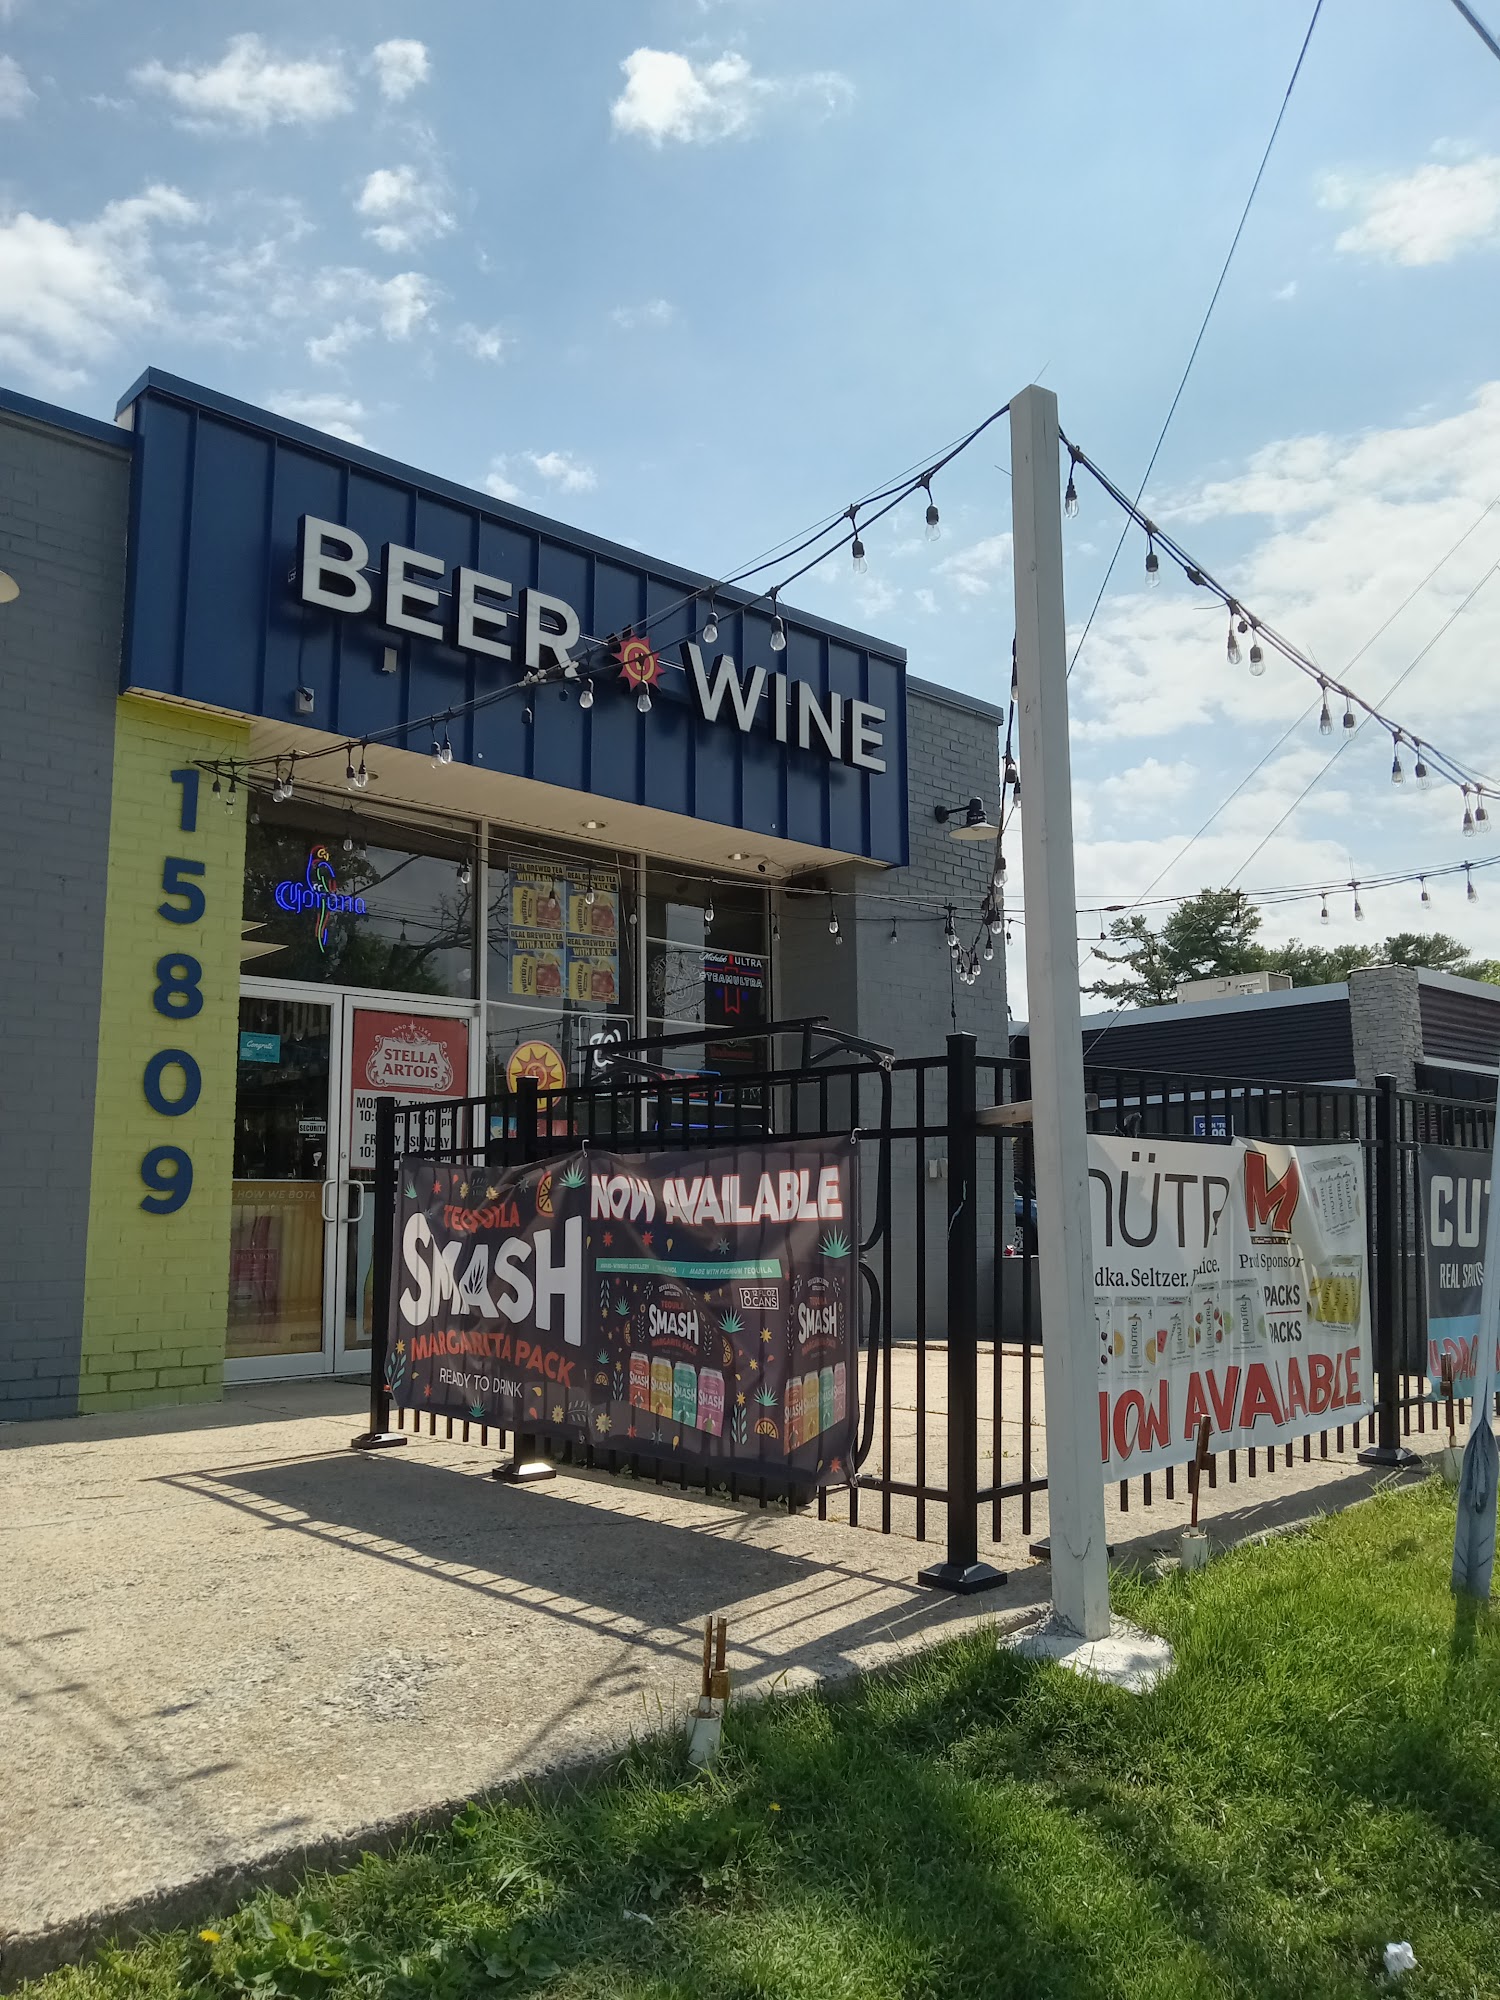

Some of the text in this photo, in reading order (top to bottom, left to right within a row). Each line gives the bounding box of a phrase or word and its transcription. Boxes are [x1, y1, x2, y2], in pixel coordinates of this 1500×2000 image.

[300, 514, 581, 682] BEER
[683, 640, 886, 773] WINE
[552, 865, 563, 875] TEA
[567, 872, 581, 881] REAL
[606, 875, 616, 884] TEA
[275, 880, 366, 914] Corona
[511, 930, 563, 941] REAL BREWED TEA
[517, 941, 535, 949] WITH
[567, 938, 617, 948] REAL BREWED TEA
[574, 948, 591, 956] WITH
[734, 956, 762, 967] ULTRA
[699, 971, 763, 988] #TEAMULTRA
[384, 1048, 438, 1064] STELLA
[382, 1065, 438, 1079] ARTOIS
[299, 1124, 326, 1132] SECURITY
[237, 1189, 316, 1200] HOW WE BOTA
[590, 1165, 843, 1226] NOW AVAILABLE
[443, 1201, 520, 1233] TEQUILA
[689, 1266, 773, 1275] MADE WITH PREMIUM TEQUILA
[1261, 1254, 1305, 1273] Sponsor
[400, 1212, 582, 1346] SMASH
[1439, 1263, 1460, 1289] REAL
[743, 1290, 752, 1307] 8
[752, 1297, 777, 1308] CANS
[1264, 1284, 1300, 1307] PACKS
[661, 1301, 684, 1310] TEQUILA
[648, 1303, 699, 1345] SMASH
[798, 1302, 837, 1344] SMASH
[1268, 1320, 1302, 1344] PACKS
[411, 1330, 575, 1388] MARGARITA PACK
[439, 1368, 523, 1398] READY TO DRINK
[629, 1370, 649, 1390] SMASH
[650, 1377, 672, 1397] SMASH
[674, 1382, 697, 1404] SMASH
[698, 1389, 724, 1413] SMASH
